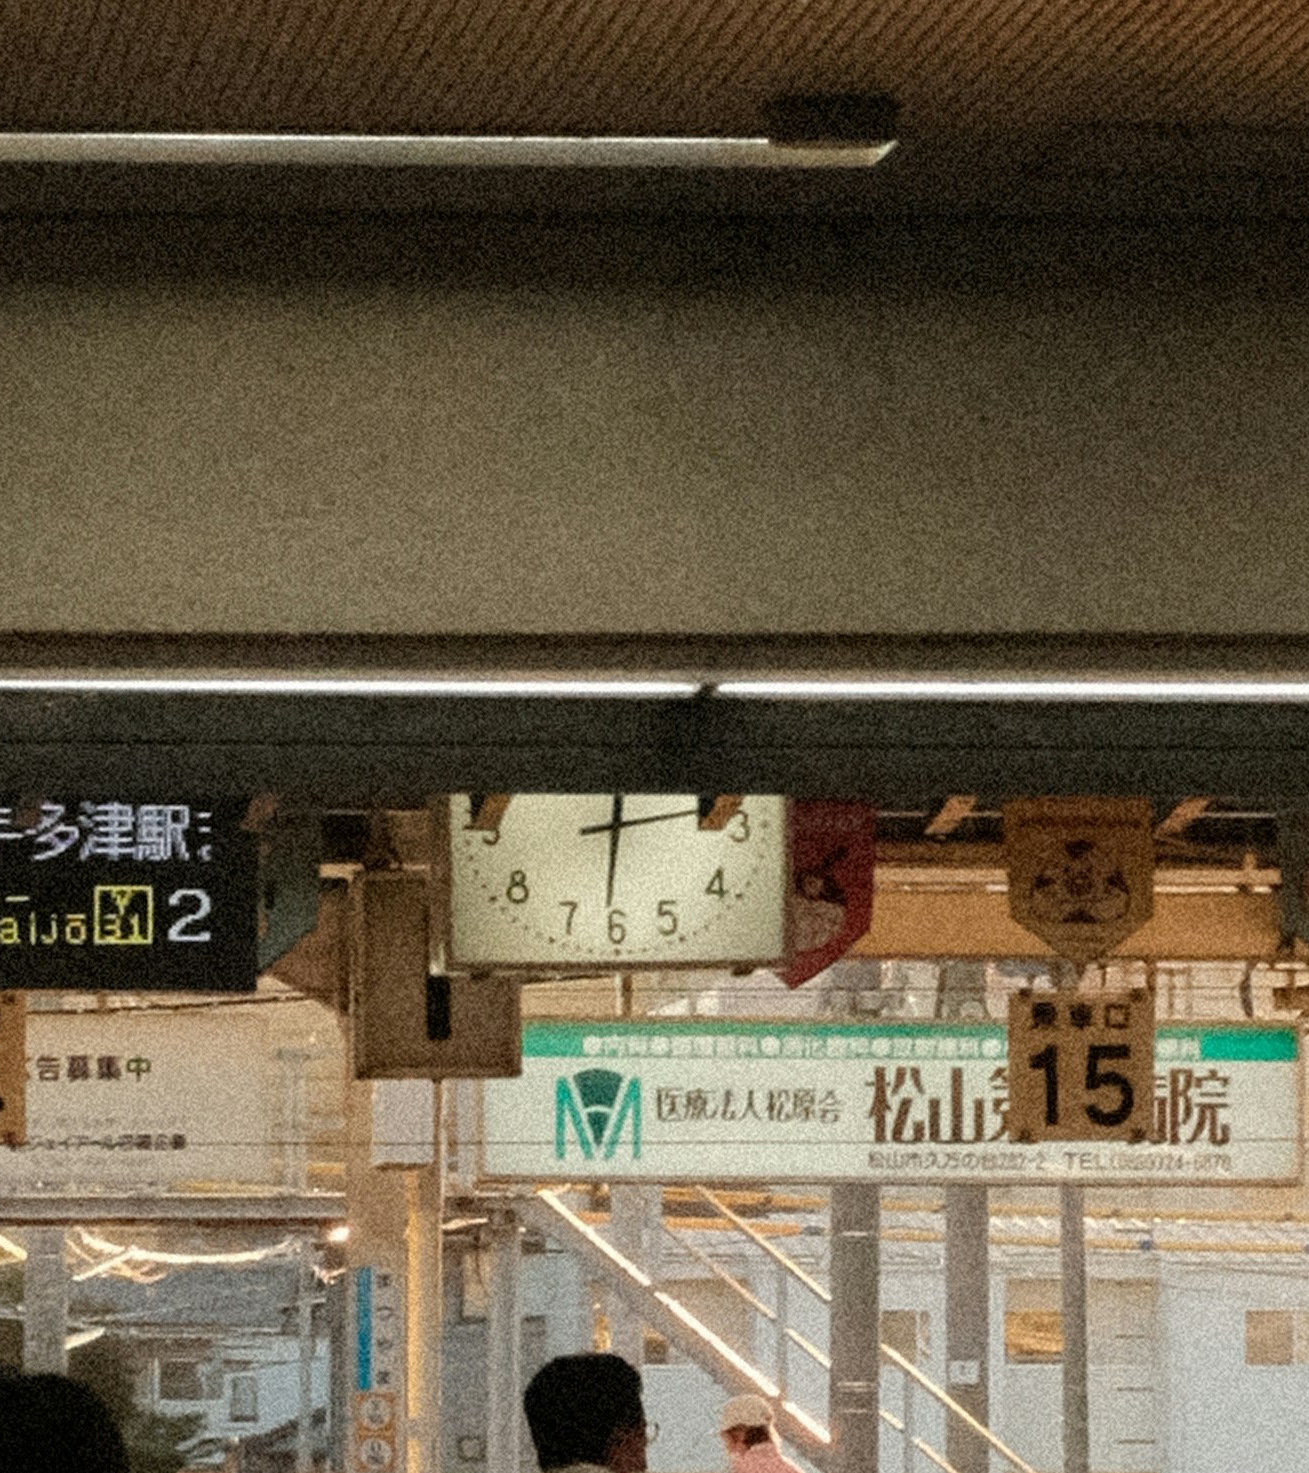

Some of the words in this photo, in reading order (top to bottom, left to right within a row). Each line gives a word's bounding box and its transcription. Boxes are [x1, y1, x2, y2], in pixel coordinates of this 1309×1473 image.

[505, 869, 530, 905] 8
[704, 867, 727, 899] 4
[167, 887, 213, 942] 2
[559, 901, 579, 936] 7
[607, 908, 628, 945] 6
[656, 900, 679, 937] 5
[28, 1054, 152, 1082] 告募集中
[1029, 1043, 1135, 1127] 15
